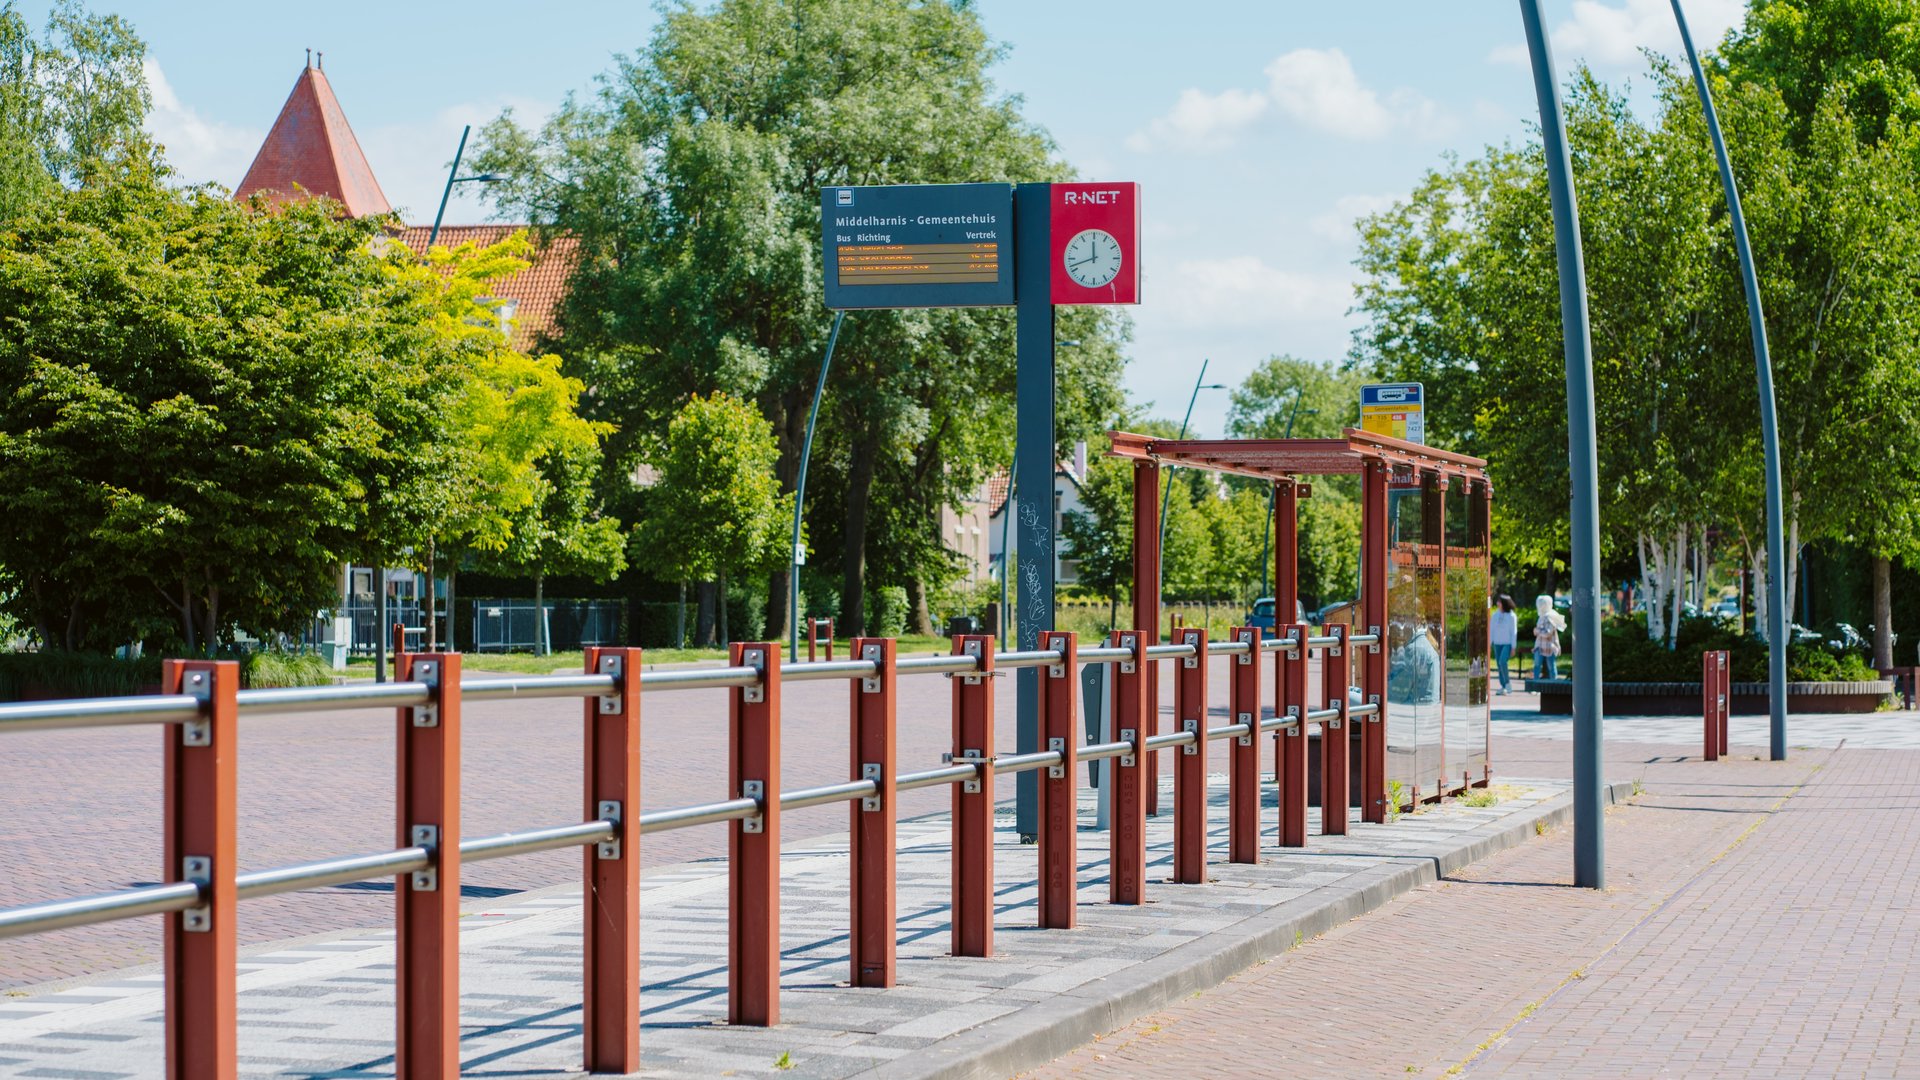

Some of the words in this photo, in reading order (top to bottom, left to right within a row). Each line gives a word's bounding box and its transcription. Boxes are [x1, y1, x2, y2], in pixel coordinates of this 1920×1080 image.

[836, 215, 907, 227] Middelharnis
[917, 213, 996, 226] Gemeentehuis
[836, 234, 851, 242] Bus
[857, 233, 891, 243] Richting
[966, 230, 997, 239] Vertrek
